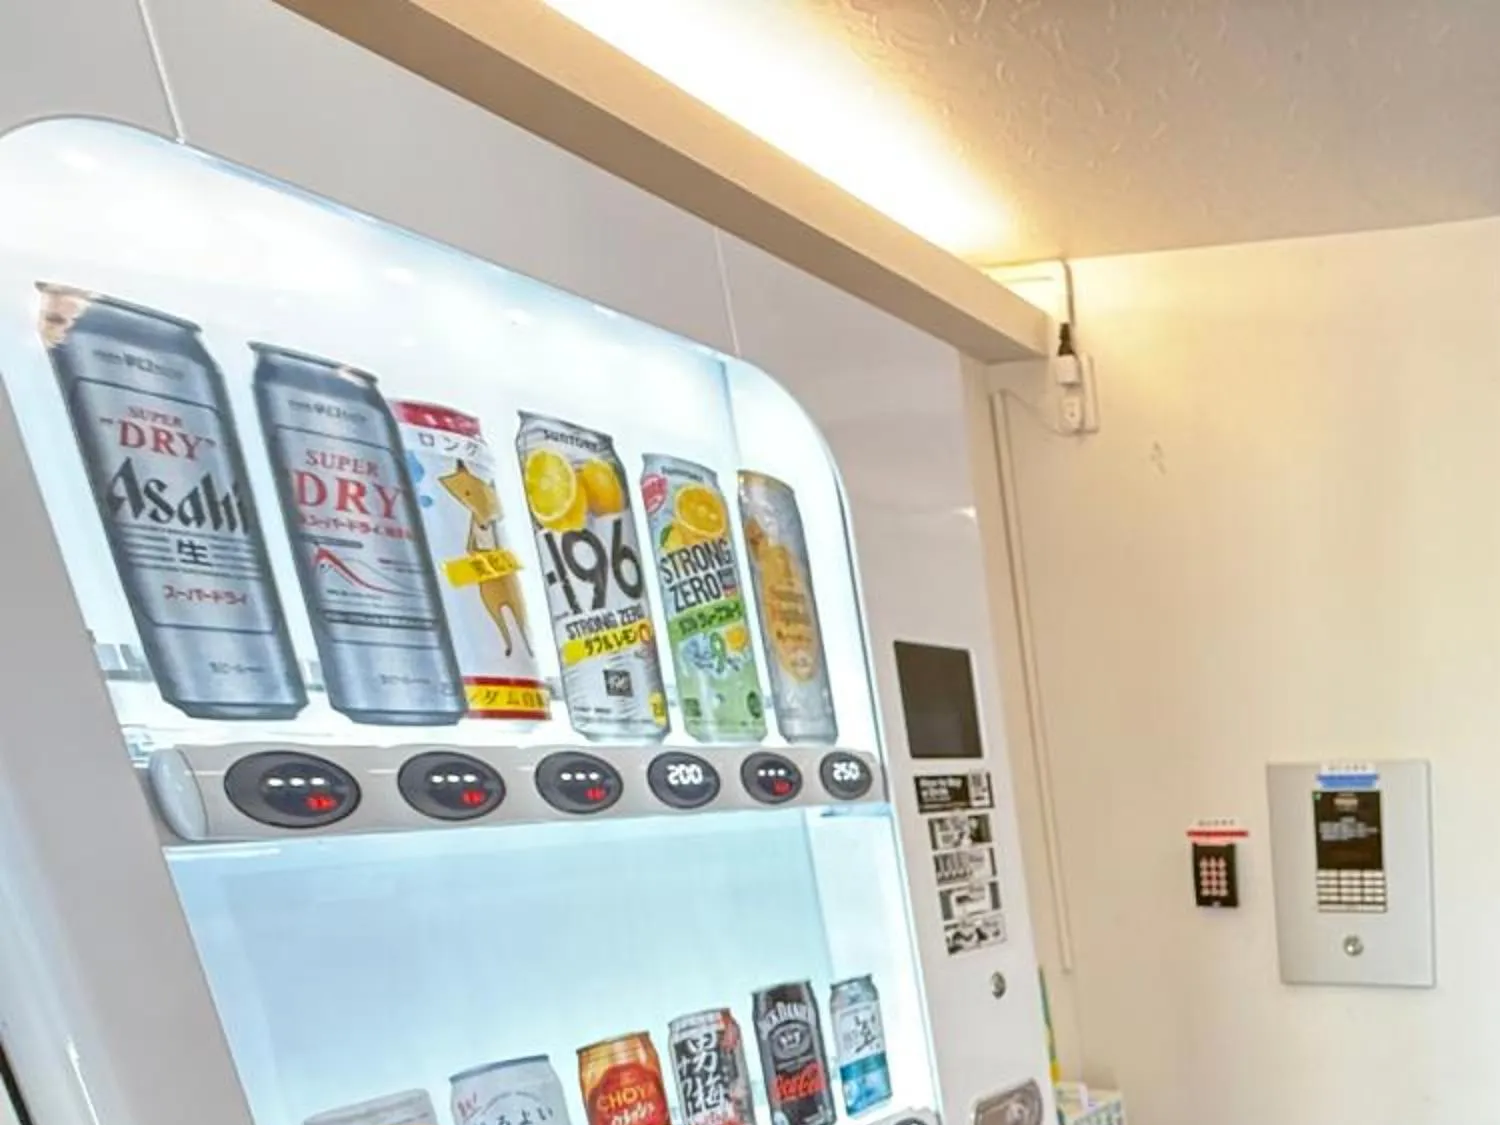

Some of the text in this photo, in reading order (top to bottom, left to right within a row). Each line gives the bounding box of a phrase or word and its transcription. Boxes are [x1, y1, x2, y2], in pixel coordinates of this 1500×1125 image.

[127, 405, 182, 427] SUPER
[119, 418, 203, 462] DRY
[305, 449, 378, 478] SUPER
[105, 456, 249, 536] Asahi
[295, 468, 405, 520] DRY
[176, 539, 213, 568] 生
[659, 536, 733, 586] STRONG
[668, 572, 722, 614] ZERO
[666, 763, 703, 785] 200
